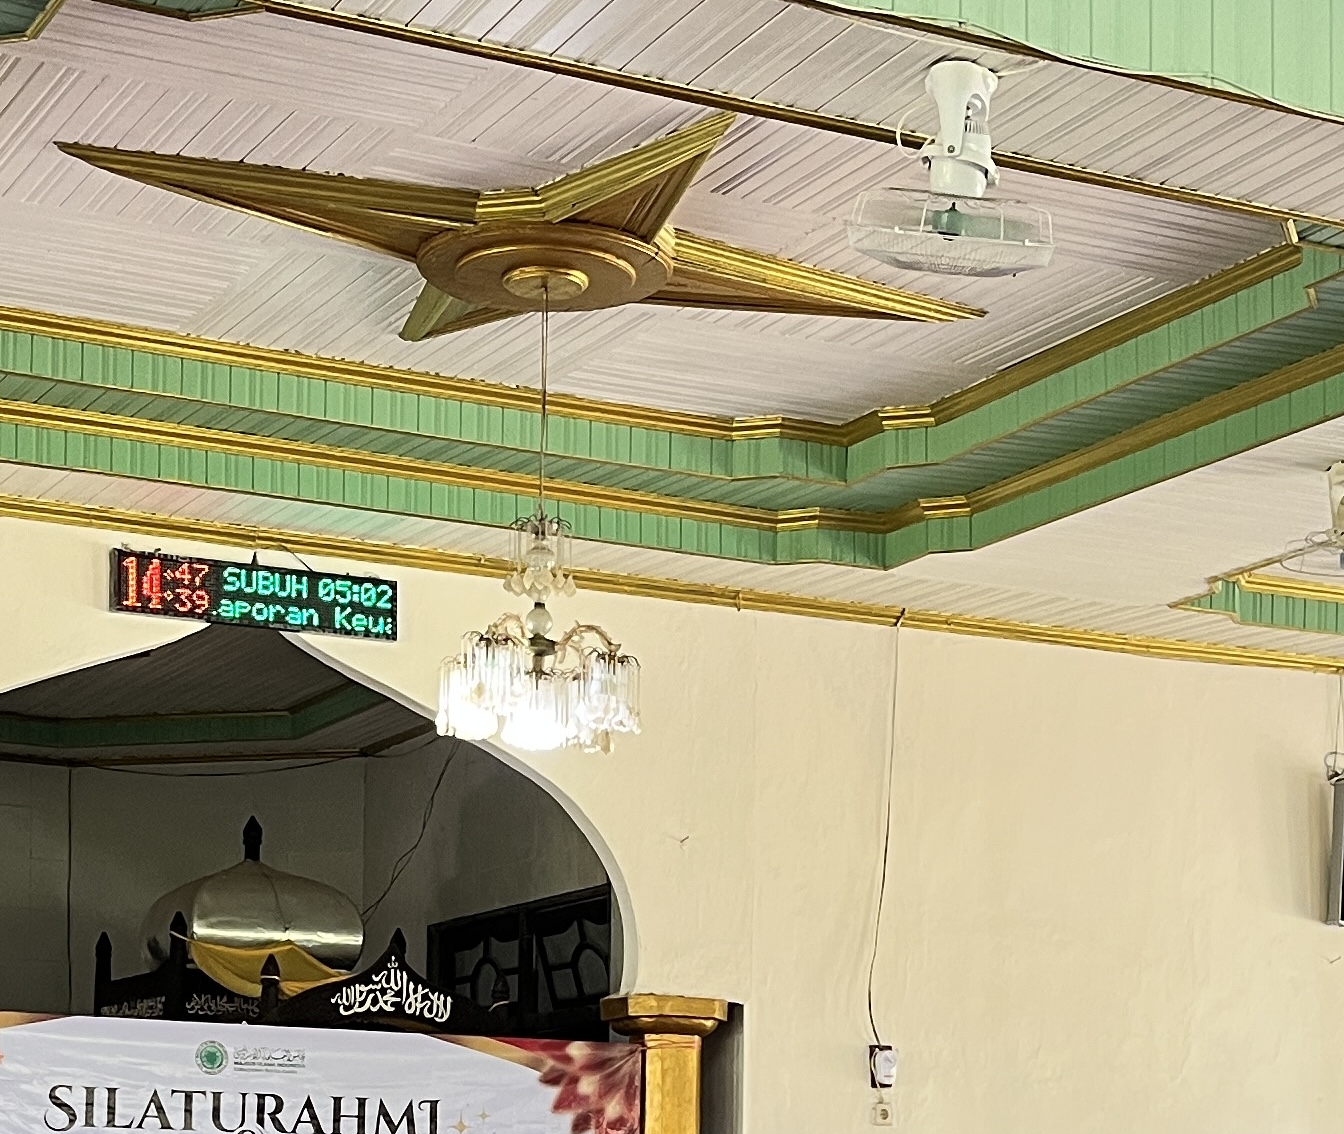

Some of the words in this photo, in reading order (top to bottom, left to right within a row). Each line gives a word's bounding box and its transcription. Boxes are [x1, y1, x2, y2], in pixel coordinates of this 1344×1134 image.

[223, 567, 309, 599] SUBUH
[318, 578, 393, 610] 05:02
[212, 599, 319, 627] aporan
